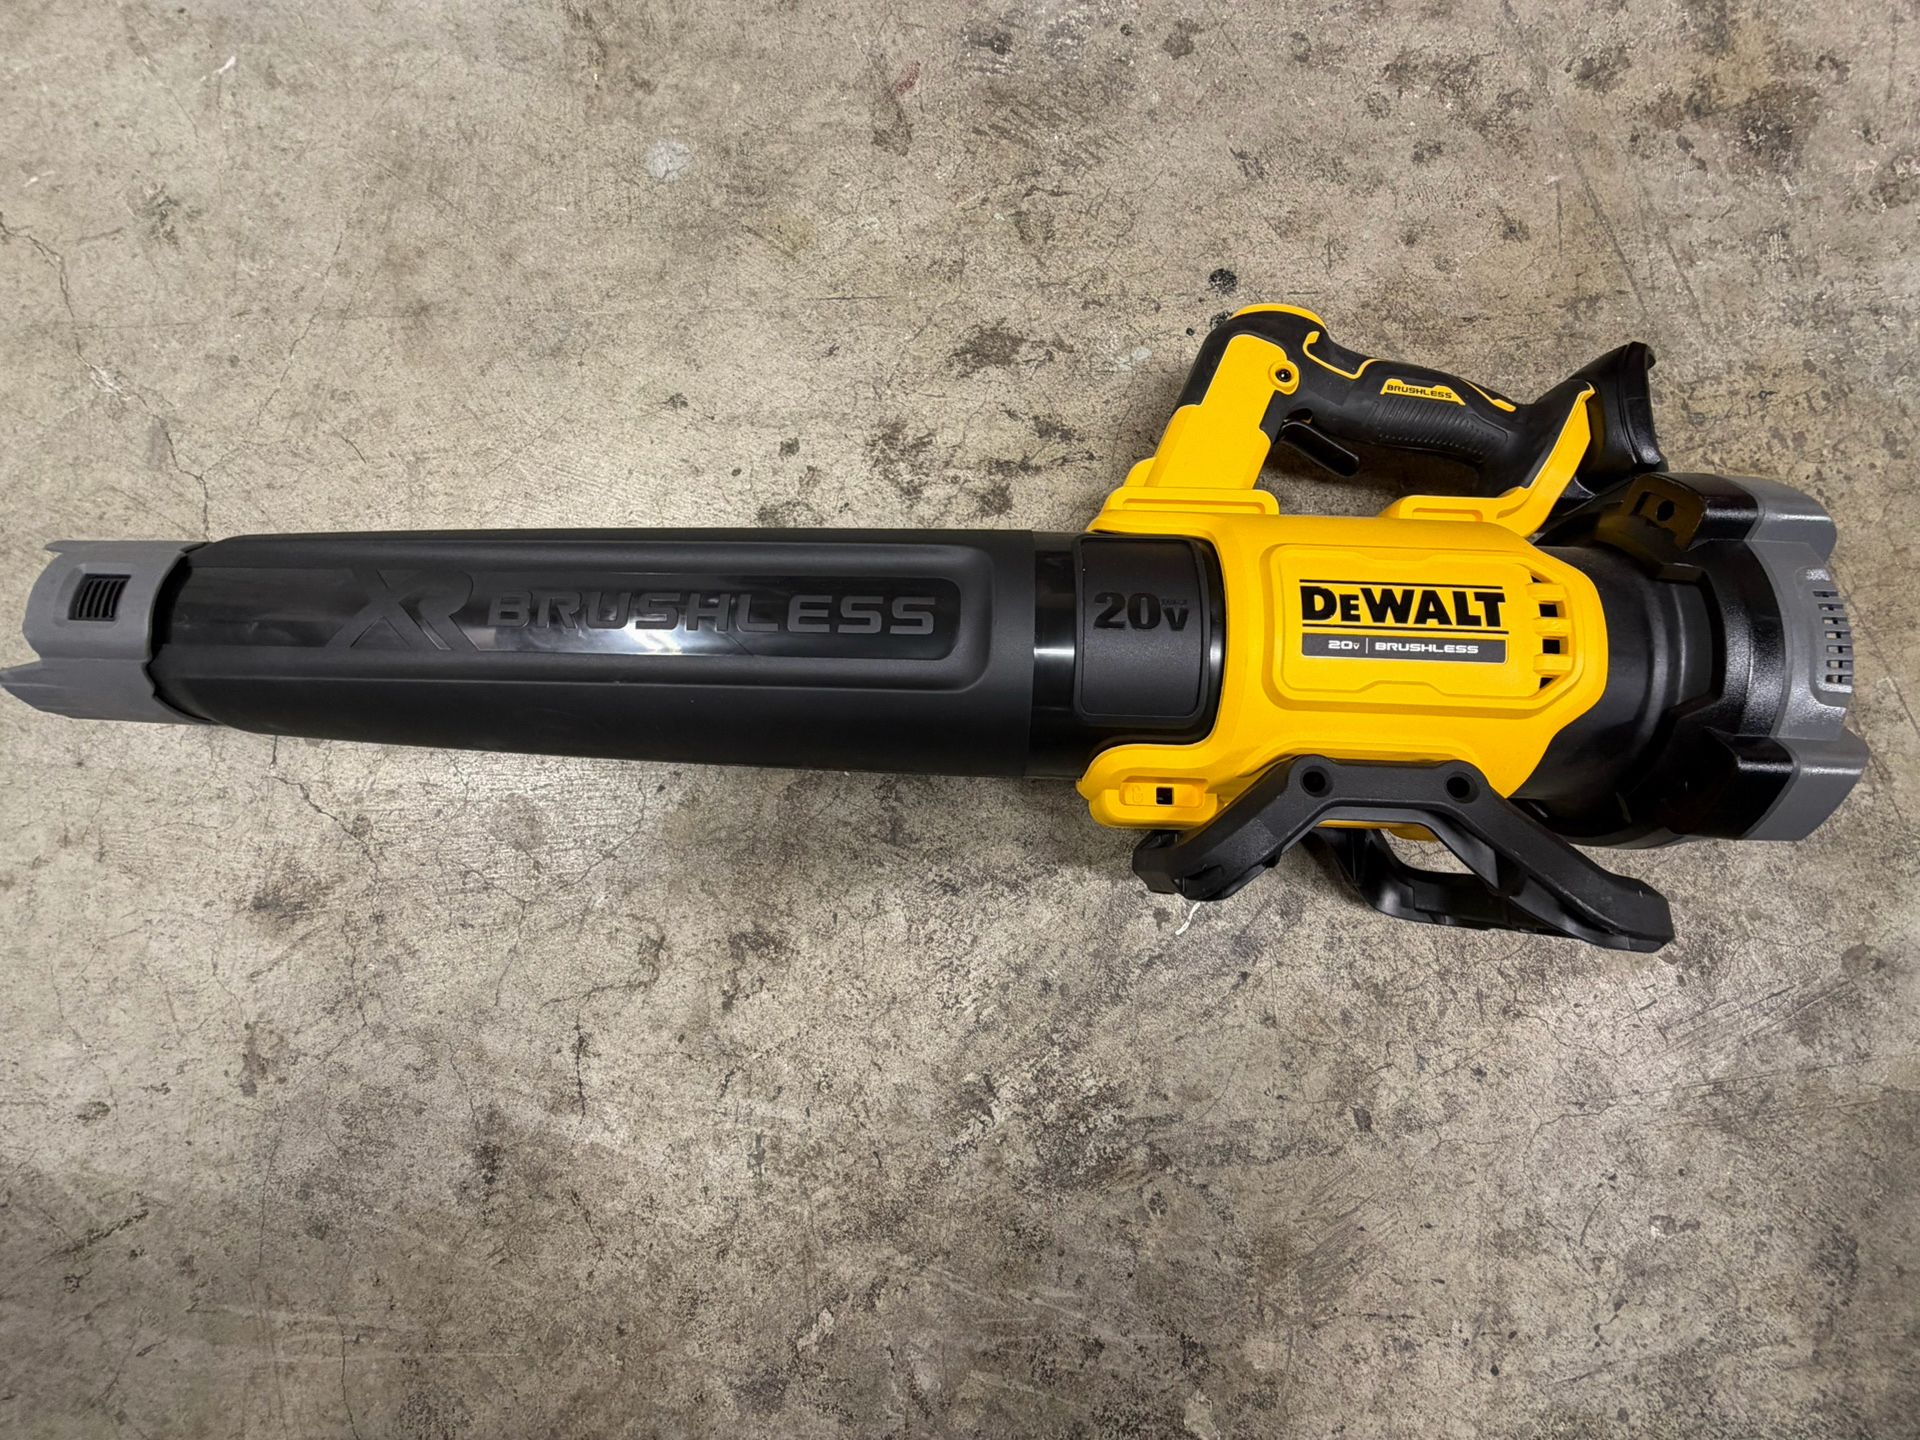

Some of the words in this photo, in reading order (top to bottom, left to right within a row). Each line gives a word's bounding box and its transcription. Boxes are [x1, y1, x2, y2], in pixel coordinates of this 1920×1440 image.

[1386, 384, 1453, 399] BRUSHLESS
[325, 568, 480, 652] XR
[487, 590, 937, 636] BRUSHLESS
[1374, 641, 1480, 655] BRUSHLESS
